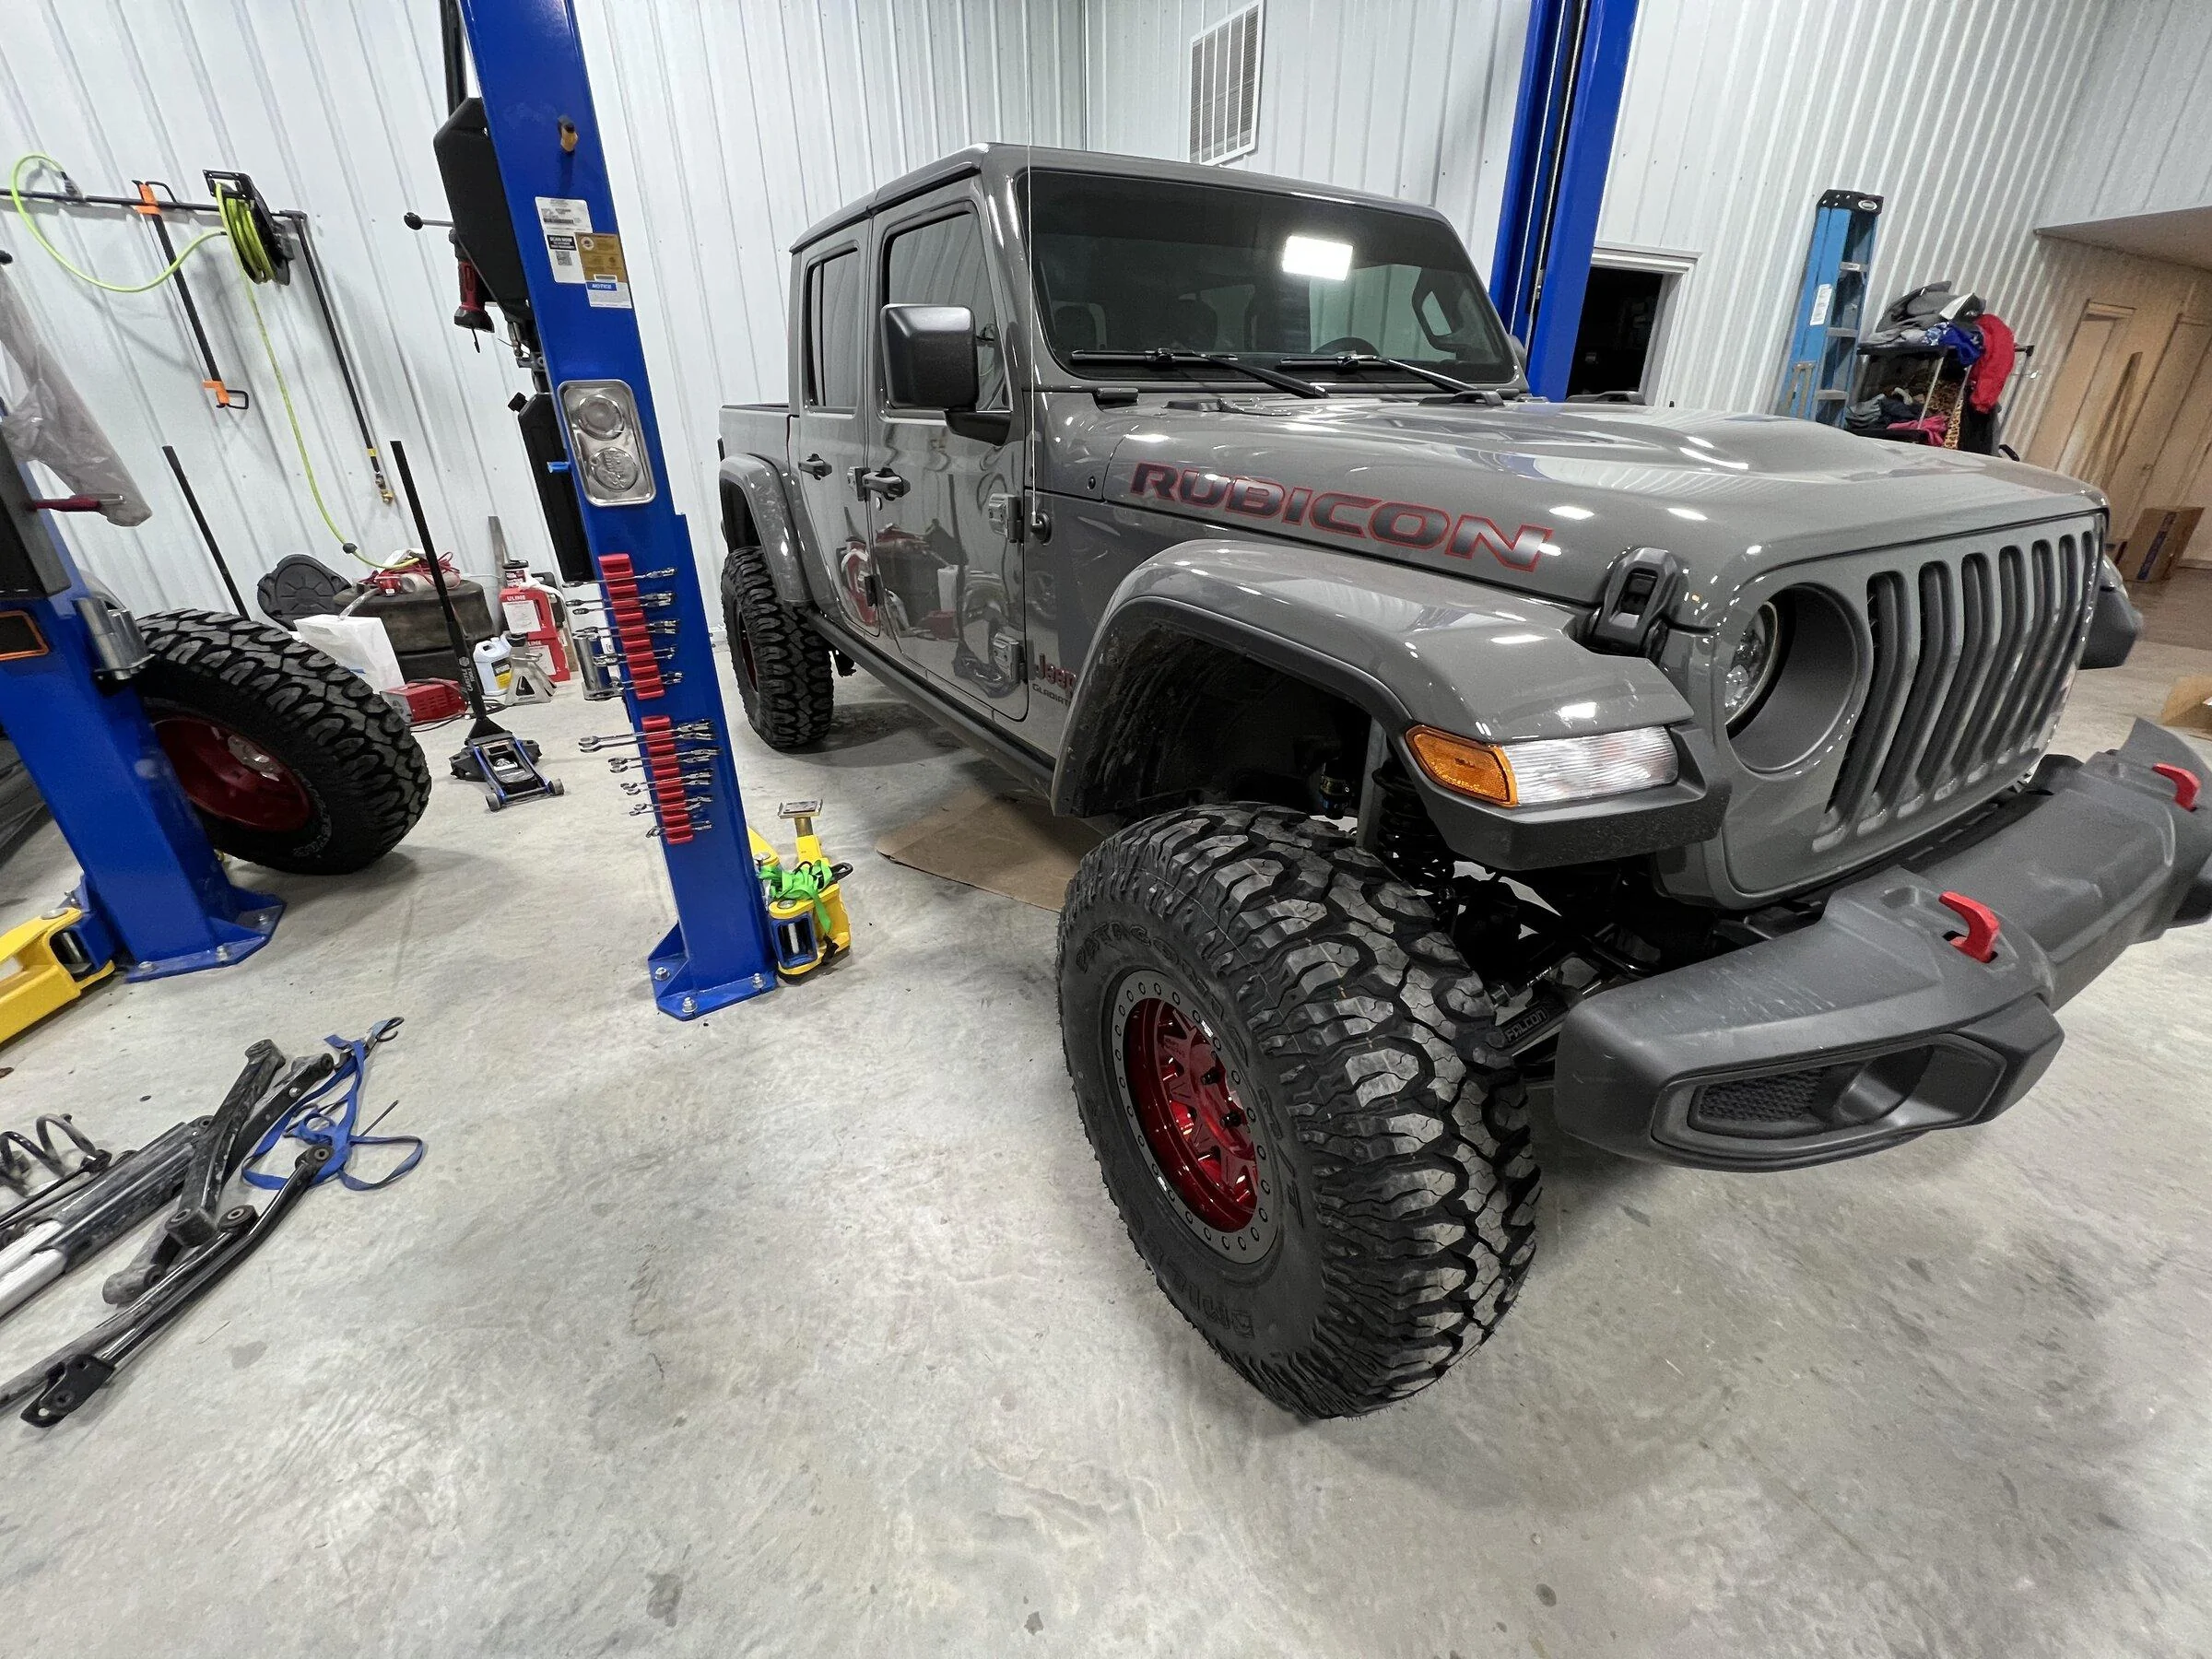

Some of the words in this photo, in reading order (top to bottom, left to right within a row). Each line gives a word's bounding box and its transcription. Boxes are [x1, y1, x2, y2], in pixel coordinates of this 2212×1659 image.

[1130, 462, 1555, 572] RUBICON
[1032, 683, 1071, 706] GLADIAT
[1034, 652, 1077, 700] Jeep
[1504, 1007, 1548, 1041] FALCON
